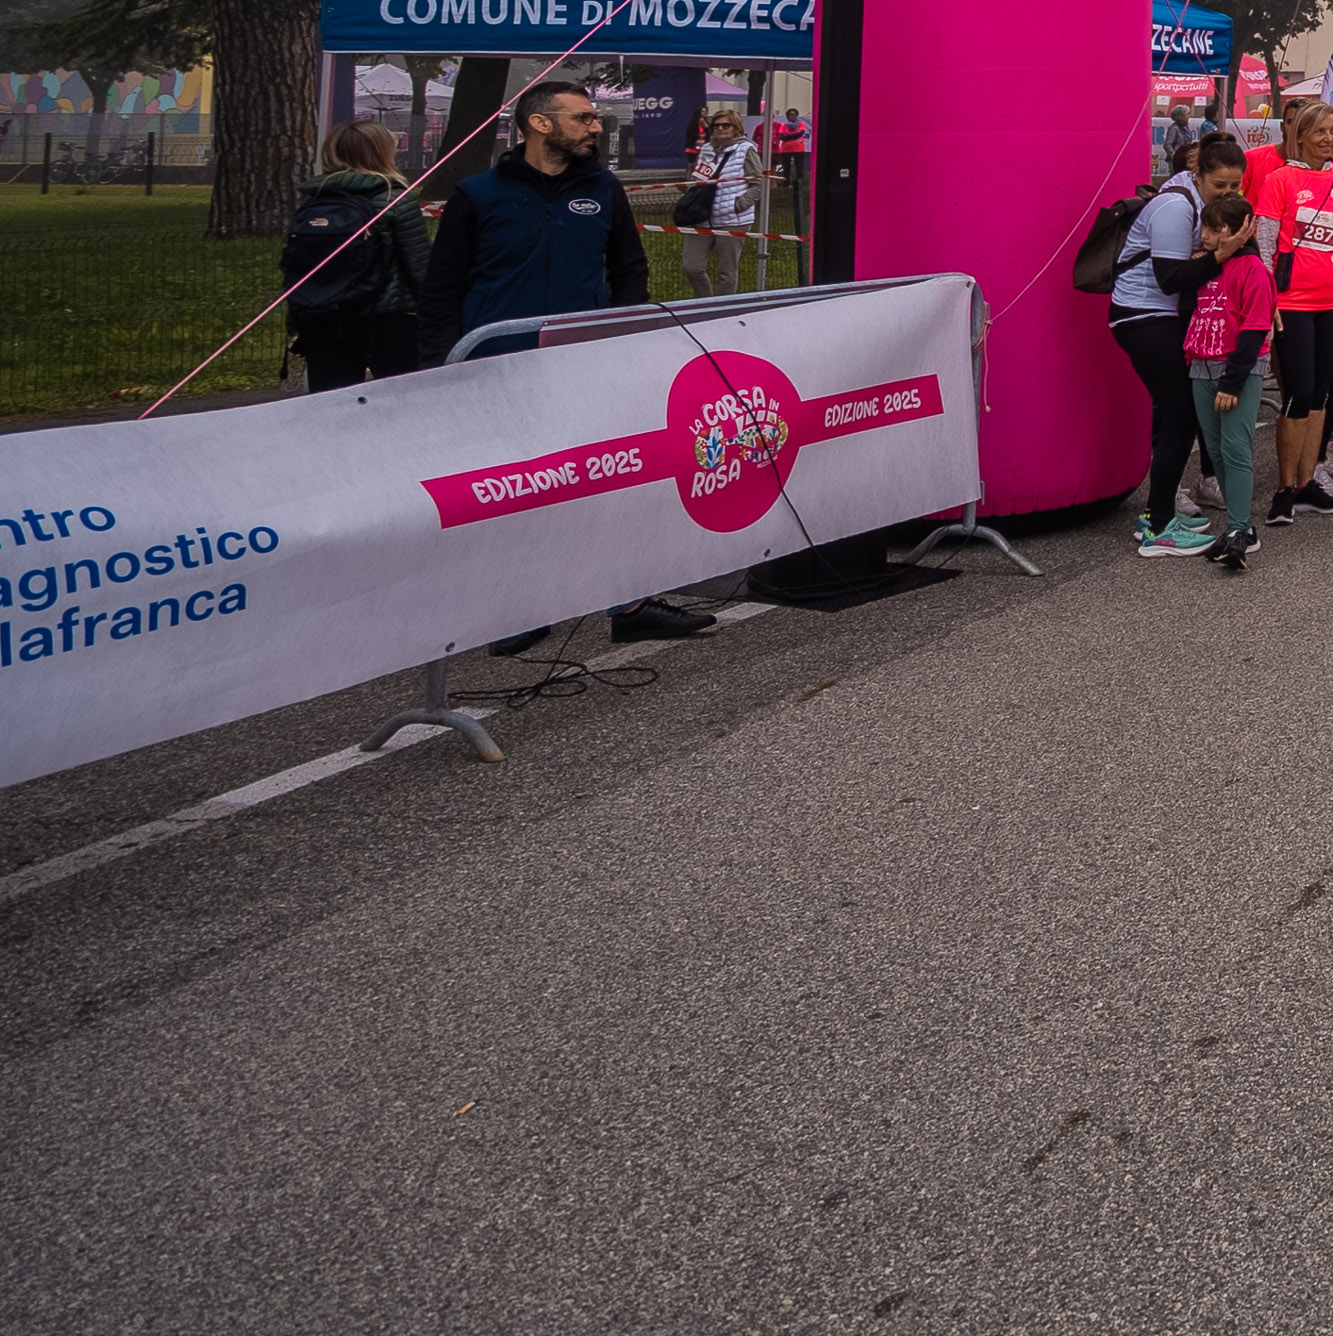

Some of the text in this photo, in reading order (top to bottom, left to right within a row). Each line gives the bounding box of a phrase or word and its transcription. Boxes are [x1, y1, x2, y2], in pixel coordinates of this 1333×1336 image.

[581, 0, 614, 26] DI
[1154, 81, 1209, 93] sportpertutti
[689, 386, 780, 436] LA CORSA IN
[824, 389, 921, 428] EDIZIONE 2025
[471, 448, 644, 504] EDIZIONE 2025
[690, 458, 741, 499] ROSA
